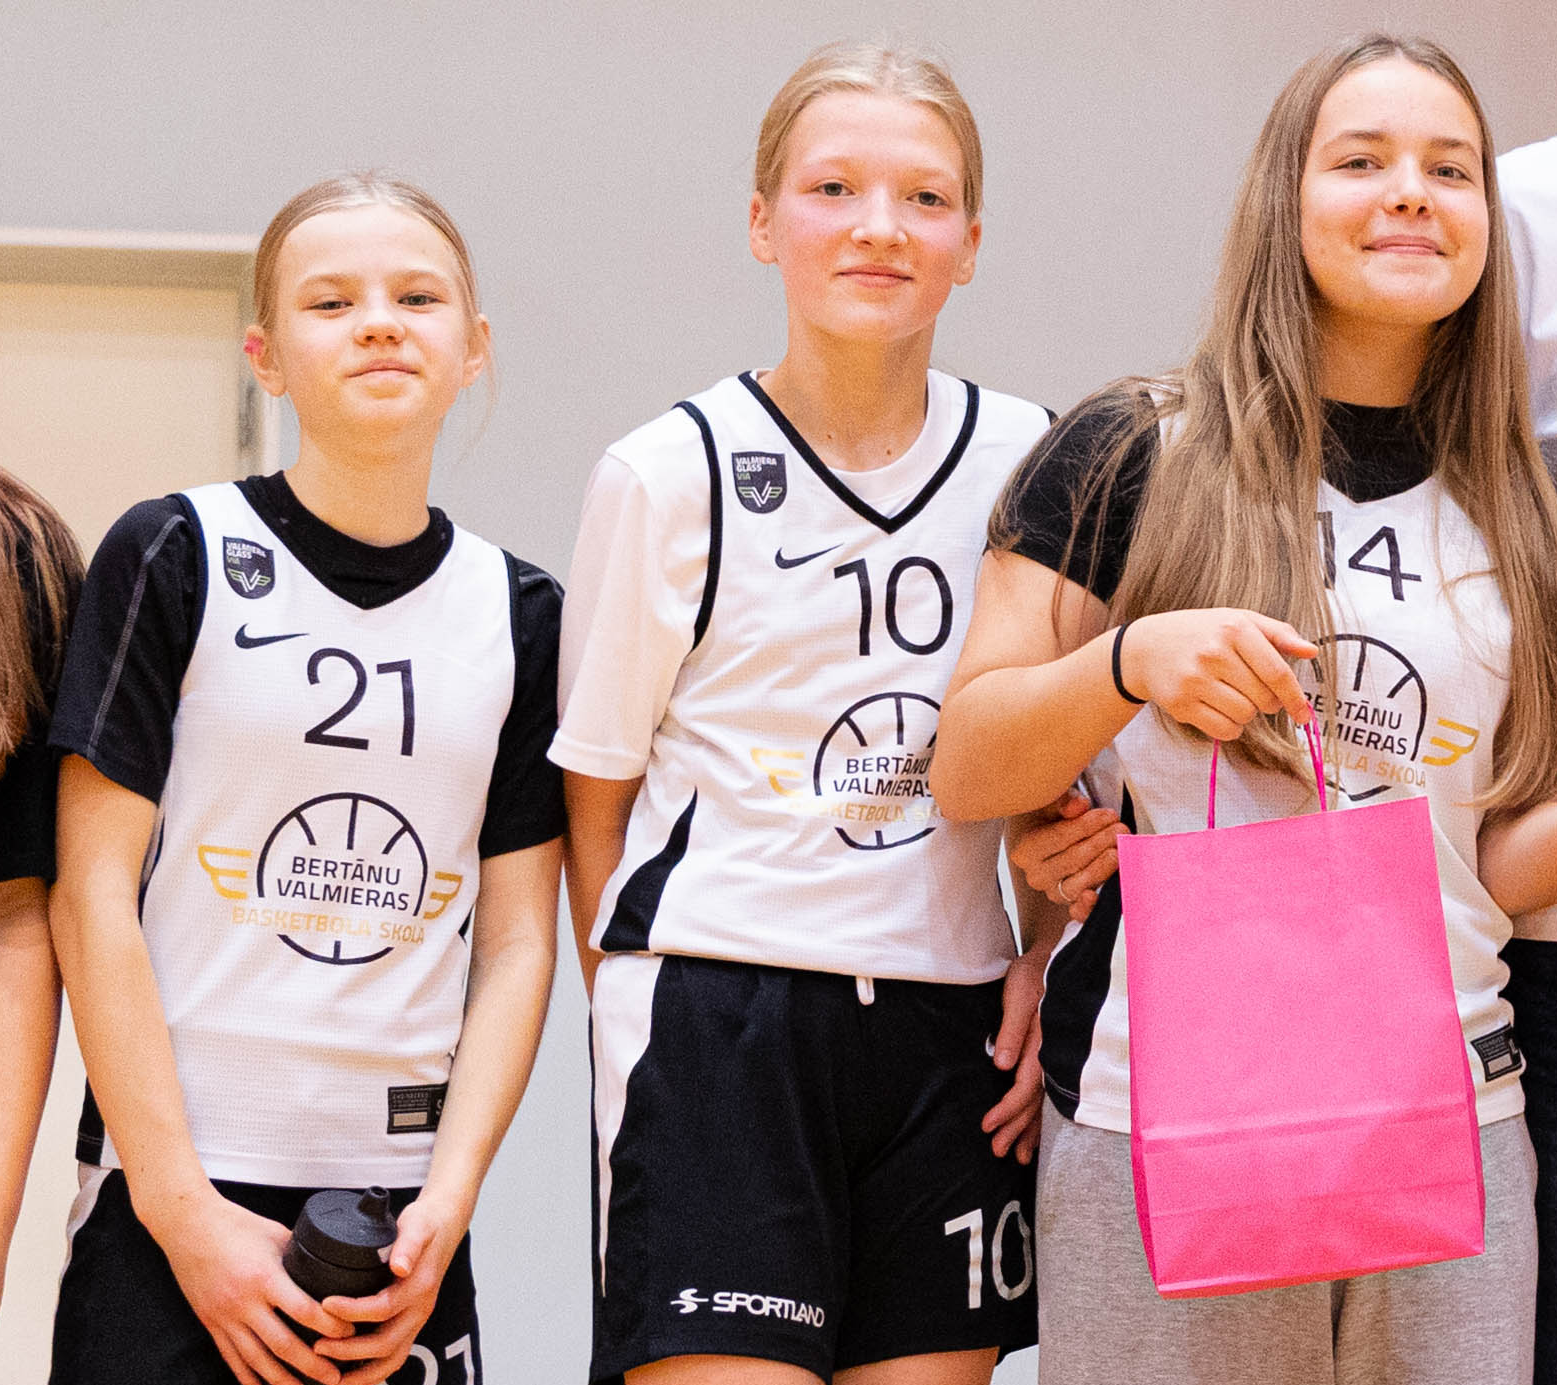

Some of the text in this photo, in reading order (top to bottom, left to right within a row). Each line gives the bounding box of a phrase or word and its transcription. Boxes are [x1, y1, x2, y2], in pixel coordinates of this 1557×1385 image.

[834, 556, 953, 657] 10
[304, 647, 416, 757] 21
[291, 856, 402, 886] BERTĀNU
[277, 877, 410, 912] VALMIERAS
[379, 921, 425, 945] SKOLA
[944, 1200, 1034, 1310] 10
[711, 1291, 825, 1328] SPORTLAND
